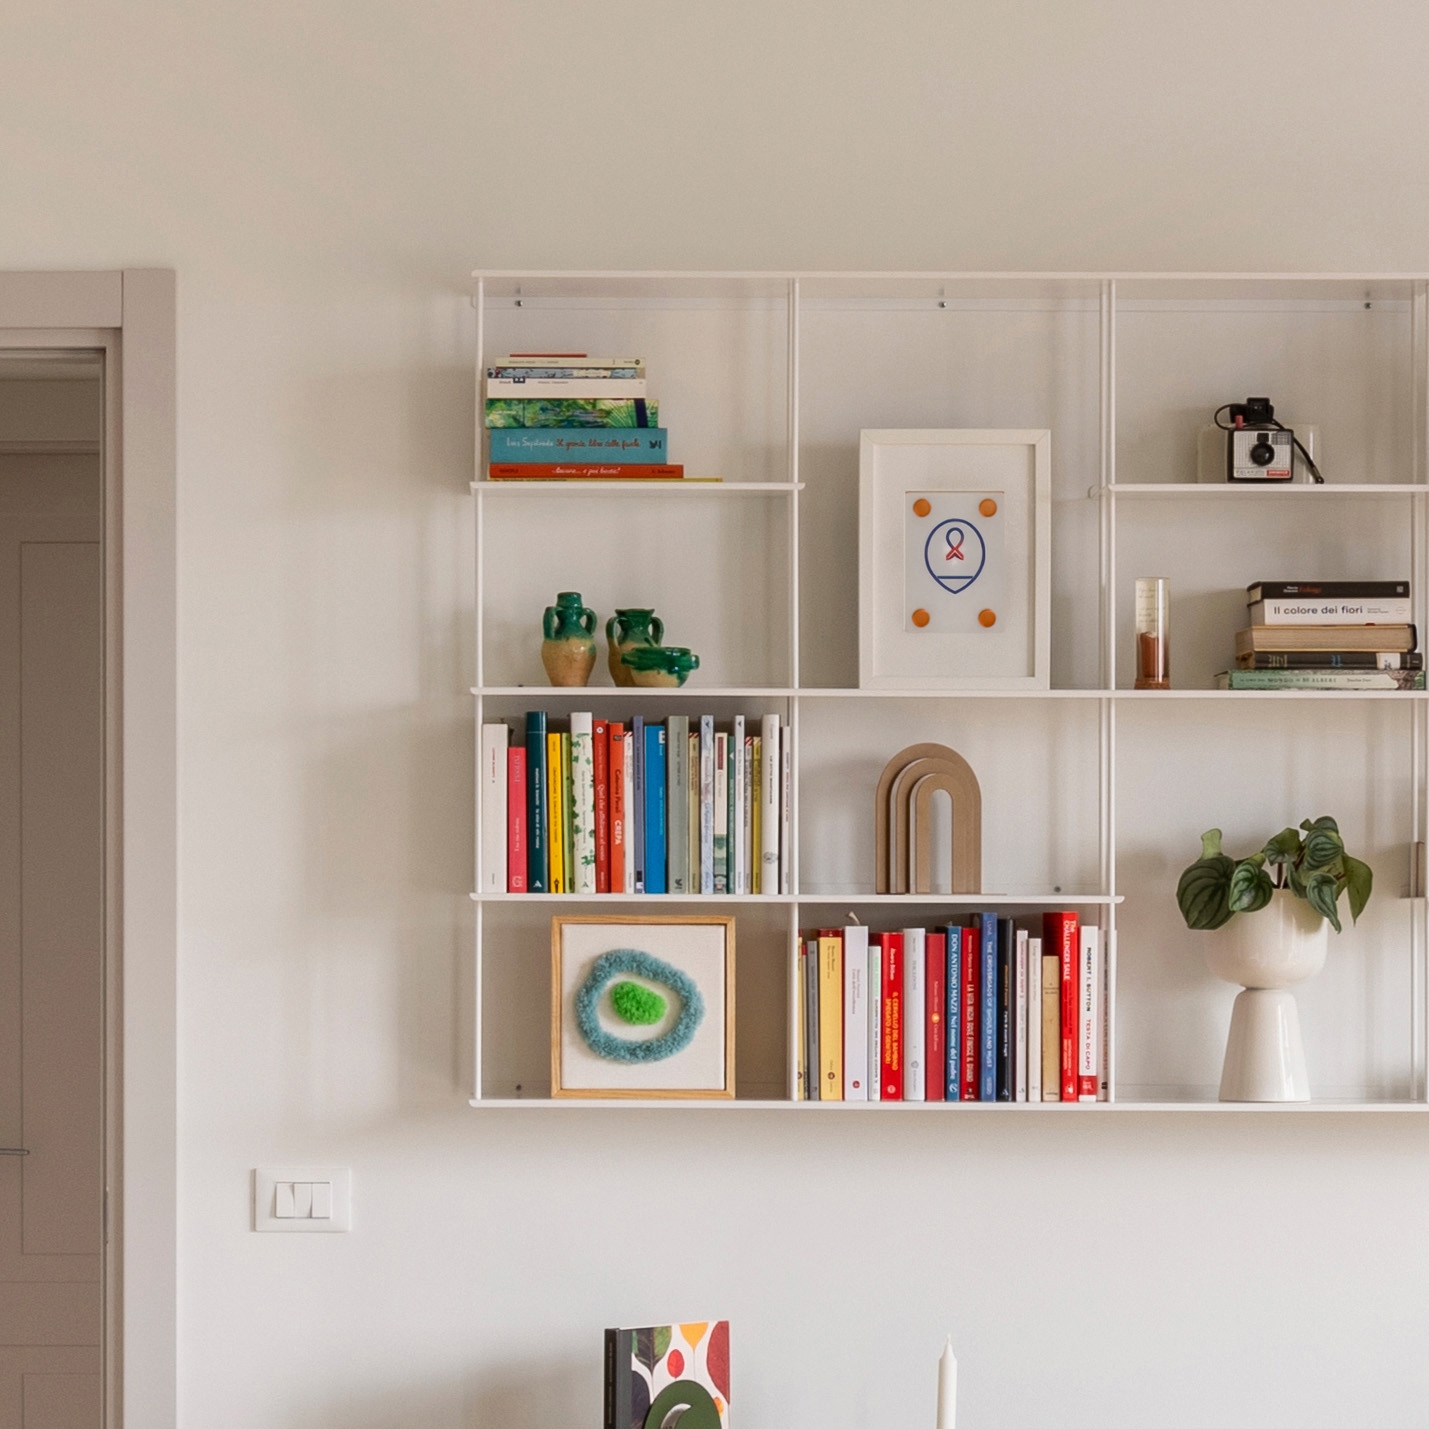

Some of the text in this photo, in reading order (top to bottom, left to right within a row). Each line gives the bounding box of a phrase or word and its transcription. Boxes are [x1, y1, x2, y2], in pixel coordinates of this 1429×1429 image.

[1274, 605, 1363, 615] Il colore dei fiori
[597, 784, 605, 798] Quel
[614, 820, 622, 845] CREPA
[1063, 920, 1071, 963] CHALLENGER
[967, 984, 974, 992] LA
[986, 997, 992, 1006] OF
[1085, 1042, 1091, 1050] DI
